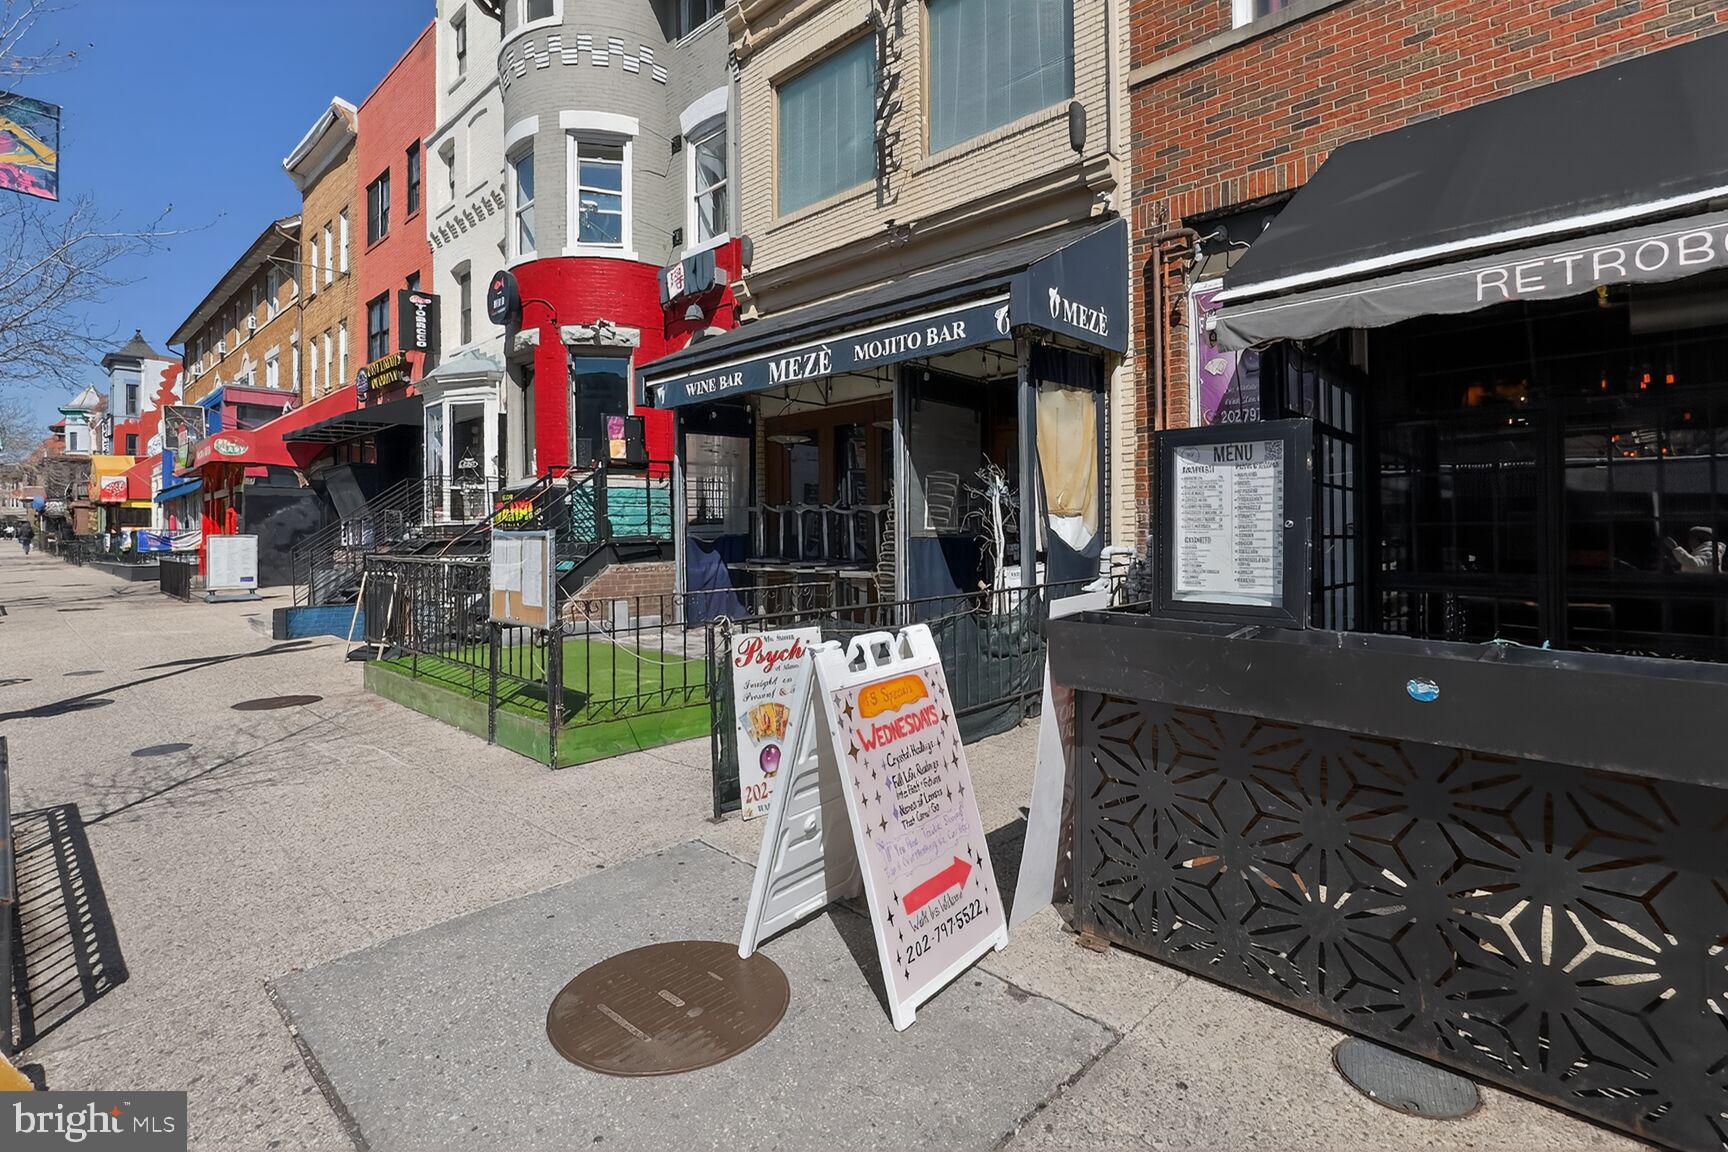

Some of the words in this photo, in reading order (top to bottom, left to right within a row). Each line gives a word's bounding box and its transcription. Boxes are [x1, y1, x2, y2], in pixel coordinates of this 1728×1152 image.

[1476, 231, 1728, 302] RETROB
[1063, 297, 1109, 337] MEZÈ
[853, 331, 921, 362] MOJITO
[926, 321, 967, 346] BAR
[685, 378, 716, 397] WINE
[719, 372, 743, 390] BAR
[768, 344, 832, 385] MEZÈ
[1213, 444, 1253, 462] MENU
[856, 704, 940, 752] WEDNESDAYS
